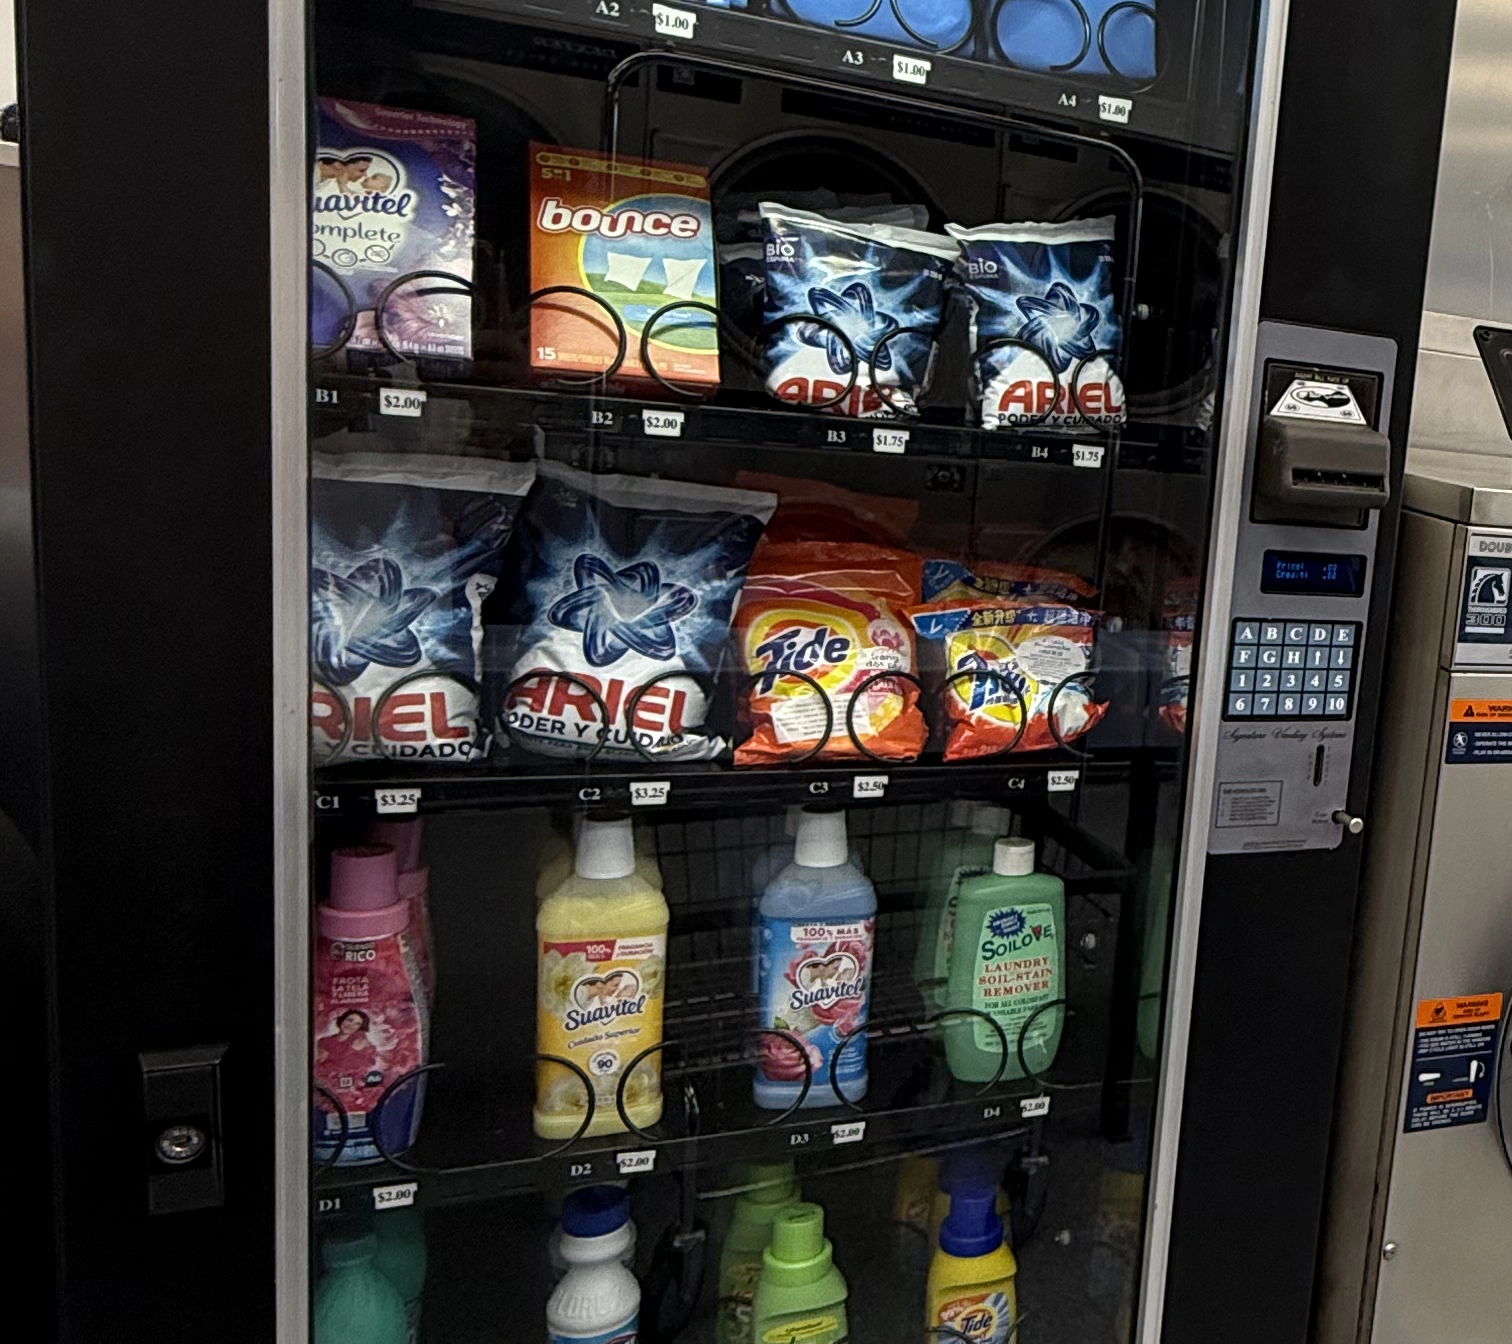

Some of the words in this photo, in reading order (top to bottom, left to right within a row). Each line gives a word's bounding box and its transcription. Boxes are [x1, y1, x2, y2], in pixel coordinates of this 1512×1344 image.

[595, 1, 620, 18] A2
[656, 12, 690, 31] $1.00
[842, 49, 864, 66] A3
[896, 60, 926, 78] $1.00
[1058, 93, 1078, 107] A4
[1100, 102, 1127, 118] $1.00
[537, 197, 701, 239] bounce
[537, 347, 556, 360] 15
[316, 389, 339, 404] B1
[384, 396, 421, 411] $2.00
[997, 379, 1122, 415] ARIEL
[592, 411, 614, 425] B2
[646, 416, 678, 429] $2.00
[1051, 415, 1061, 425] Y
[827, 429, 846, 443] B3
[876, 435, 904, 447] $1.75
[1031, 446, 1049, 458] B4
[1074, 450, 1099, 462] $1.75
[1240, 627, 1253, 640] A
[1267, 627, 1278, 640] B
[1290, 628, 1303, 640] C
[1313, 628, 1327, 641] D
[1337, 629, 1349, 641] E
[755, 627, 851, 696] Tide
[1239, 651, 1251, 663] F
[1263, 651, 1276, 664] G
[1287, 651, 1301, 664] H
[1239, 675, 1245, 687] 1
[1262, 675, 1271, 687] 2
[1286, 675, 1296, 687] 3
[1310, 675, 1320, 687] 4
[1334, 675, 1343, 687] 5
[503, 667, 687, 734] ARIEL
[1235, 698, 1245, 710] 6
[1261, 698, 1270, 710] 7
[1284, 698, 1294, 710] 8
[1308, 698, 1317, 710] 9
[1329, 698, 1345, 710] 10
[312, 691, 470, 742] RIEL
[574, 722, 591, 738] Y
[809, 781, 829, 794] C3
[857, 781, 884, 793] $2.50
[1008, 777, 1025, 789] C4
[1051, 775, 1075, 787] $2.50
[380, 793, 416, 807] $3.25
[578, 788, 600, 801] C2
[634, 787, 666, 800] $3.25
[316, 795, 340, 809] C1
[345, 950, 376, 962] RICO
[985, 956, 1050, 973] LAUNDRY
[978, 967, 1054, 986] SOIL-STAIN
[790, 977, 865, 1010] Suavitel
[983, 980, 1050, 998] REMOVER
[565, 994, 646, 1031] Suavitel
[984, 1107, 1001, 1118] D4
[790, 1133, 809, 1145] D3
[834, 1127, 860, 1139] $2.00
[570, 1163, 592, 1175] D2
[619, 1156, 649, 1169] $2.00
[377, 1188, 412, 1203] $2.00
[319, 1198, 341, 1211] D1
[960, 1311, 993, 1334] Tide
